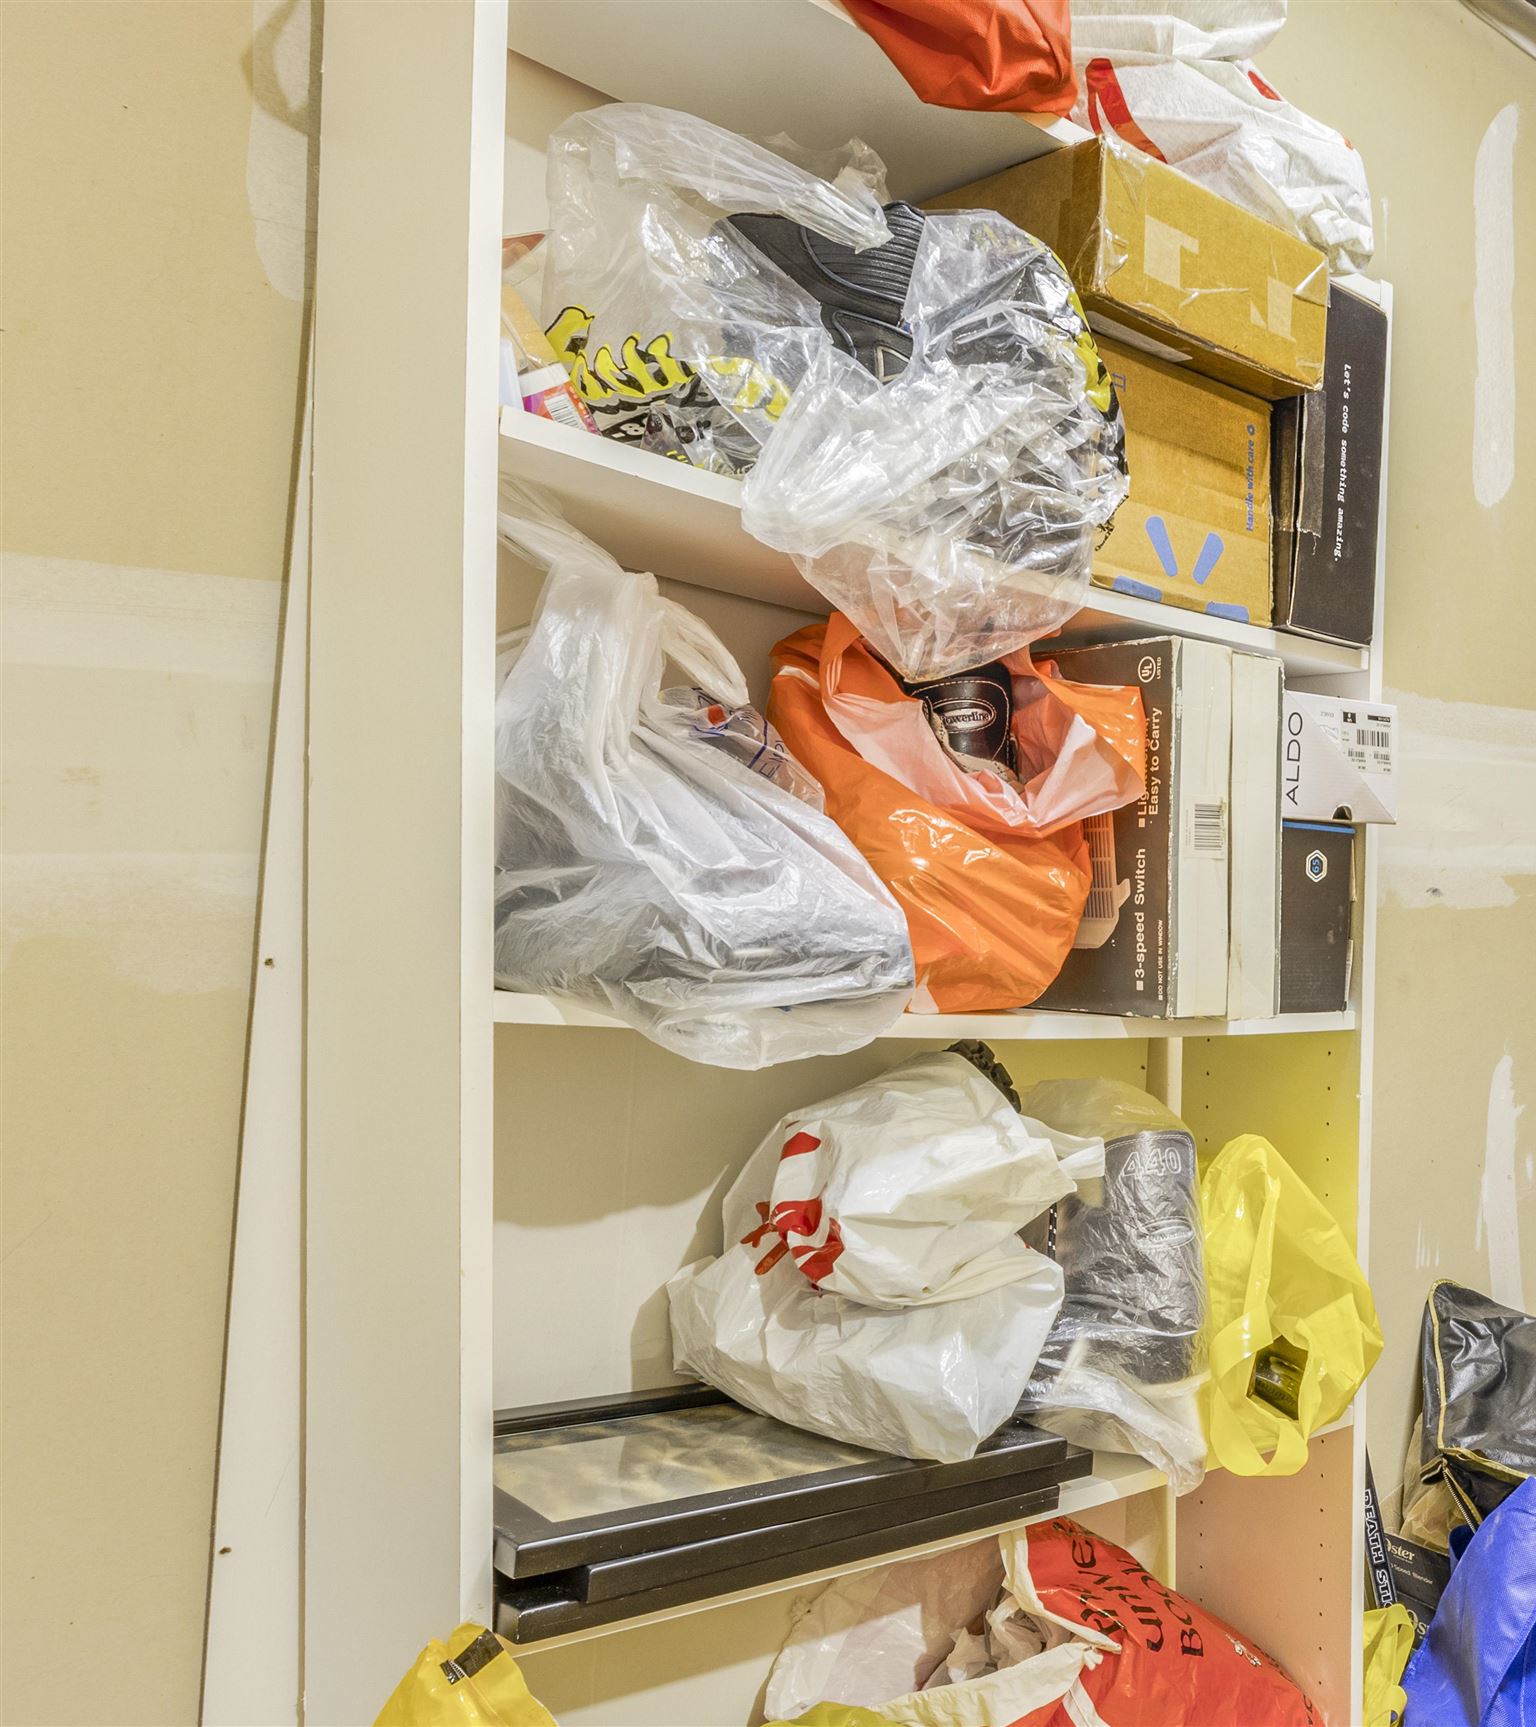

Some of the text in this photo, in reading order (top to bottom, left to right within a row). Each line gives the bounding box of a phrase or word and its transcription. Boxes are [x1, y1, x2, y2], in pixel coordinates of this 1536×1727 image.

[1246, 440, 1255, 532] Handle with care
[1333, 363, 1352, 562] Let's code something amazing.
[1148, 706, 1163, 816] Easy to Carry
[1286, 711, 1303, 806] ALDO
[1134, 847, 1147, 978] 3-speed Switch
[1158, 946, 1163, 954] IN
[1158, 985, 1163, 994] DO
[1363, 1489, 1387, 1564] DEATH
